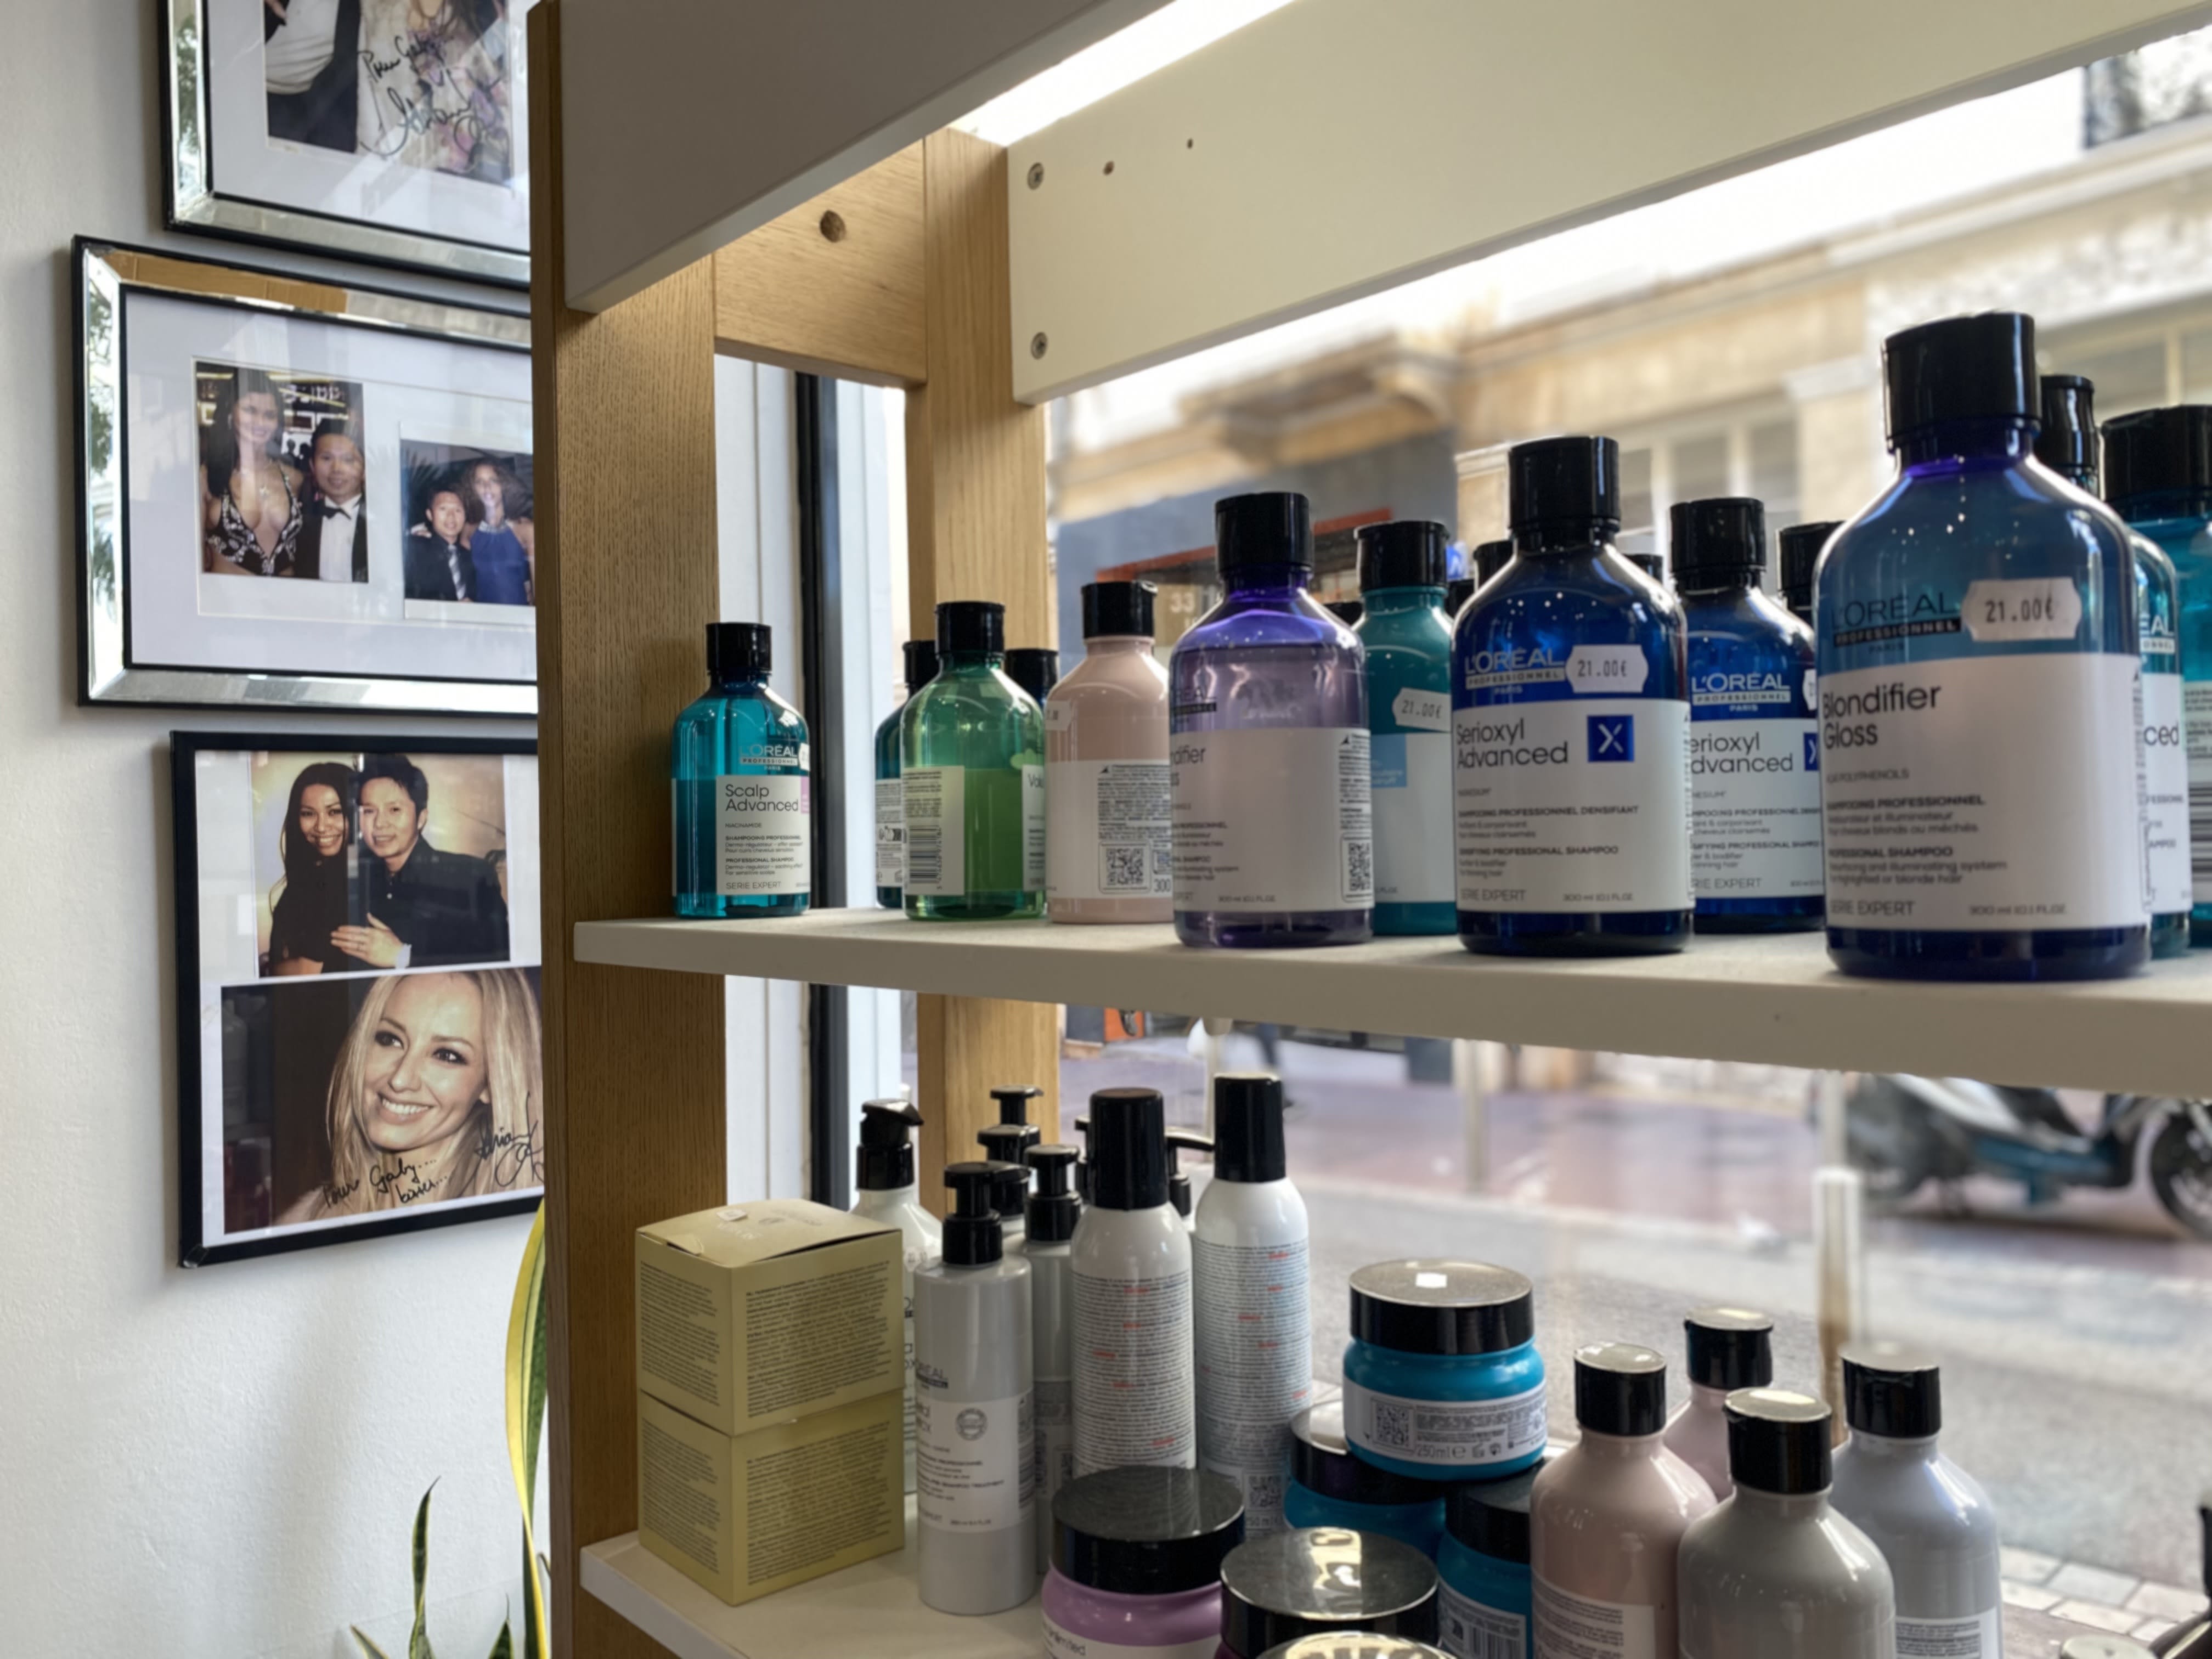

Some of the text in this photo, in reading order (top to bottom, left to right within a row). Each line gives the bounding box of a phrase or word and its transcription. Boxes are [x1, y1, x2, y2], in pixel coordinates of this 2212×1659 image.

[1985, 598, 2054, 623] 21.00€
[1465, 647, 1564, 674] L'ORÉAL
[1578, 660, 1627, 677] 21.00€
[1469, 670, 1560, 686] PROFESSIONNEL
[1691, 672, 1791, 692] L'ORÉAL
[1494, 686, 1523, 695] PARIS
[1697, 693, 1786, 703] PROFESSIONNEL
[1822, 682, 1942, 719] Blondifier
[1401, 699, 1443, 719] 21.00€
[1457, 718, 1524, 746] Serioxyl
[1824, 723, 1878, 749] Gloss
[741, 744, 797, 757] L'ORÉAL
[1690, 731, 1759, 755] erioxyl
[1457, 741, 1568, 769] Advanced
[1691, 753, 1793, 775] dvanced
[725, 783, 769, 799] Scalp
[725, 799, 798, 811] Advanced
[1878, 795, 1984, 808] PROFESSIONNEL
[1566, 845, 1619, 855] SHAMPOO
[1888, 847, 1953, 857] SHAMPOO
[1714, 878, 1762, 889] EXPERT
[1858, 900, 1915, 916] EXPERT
